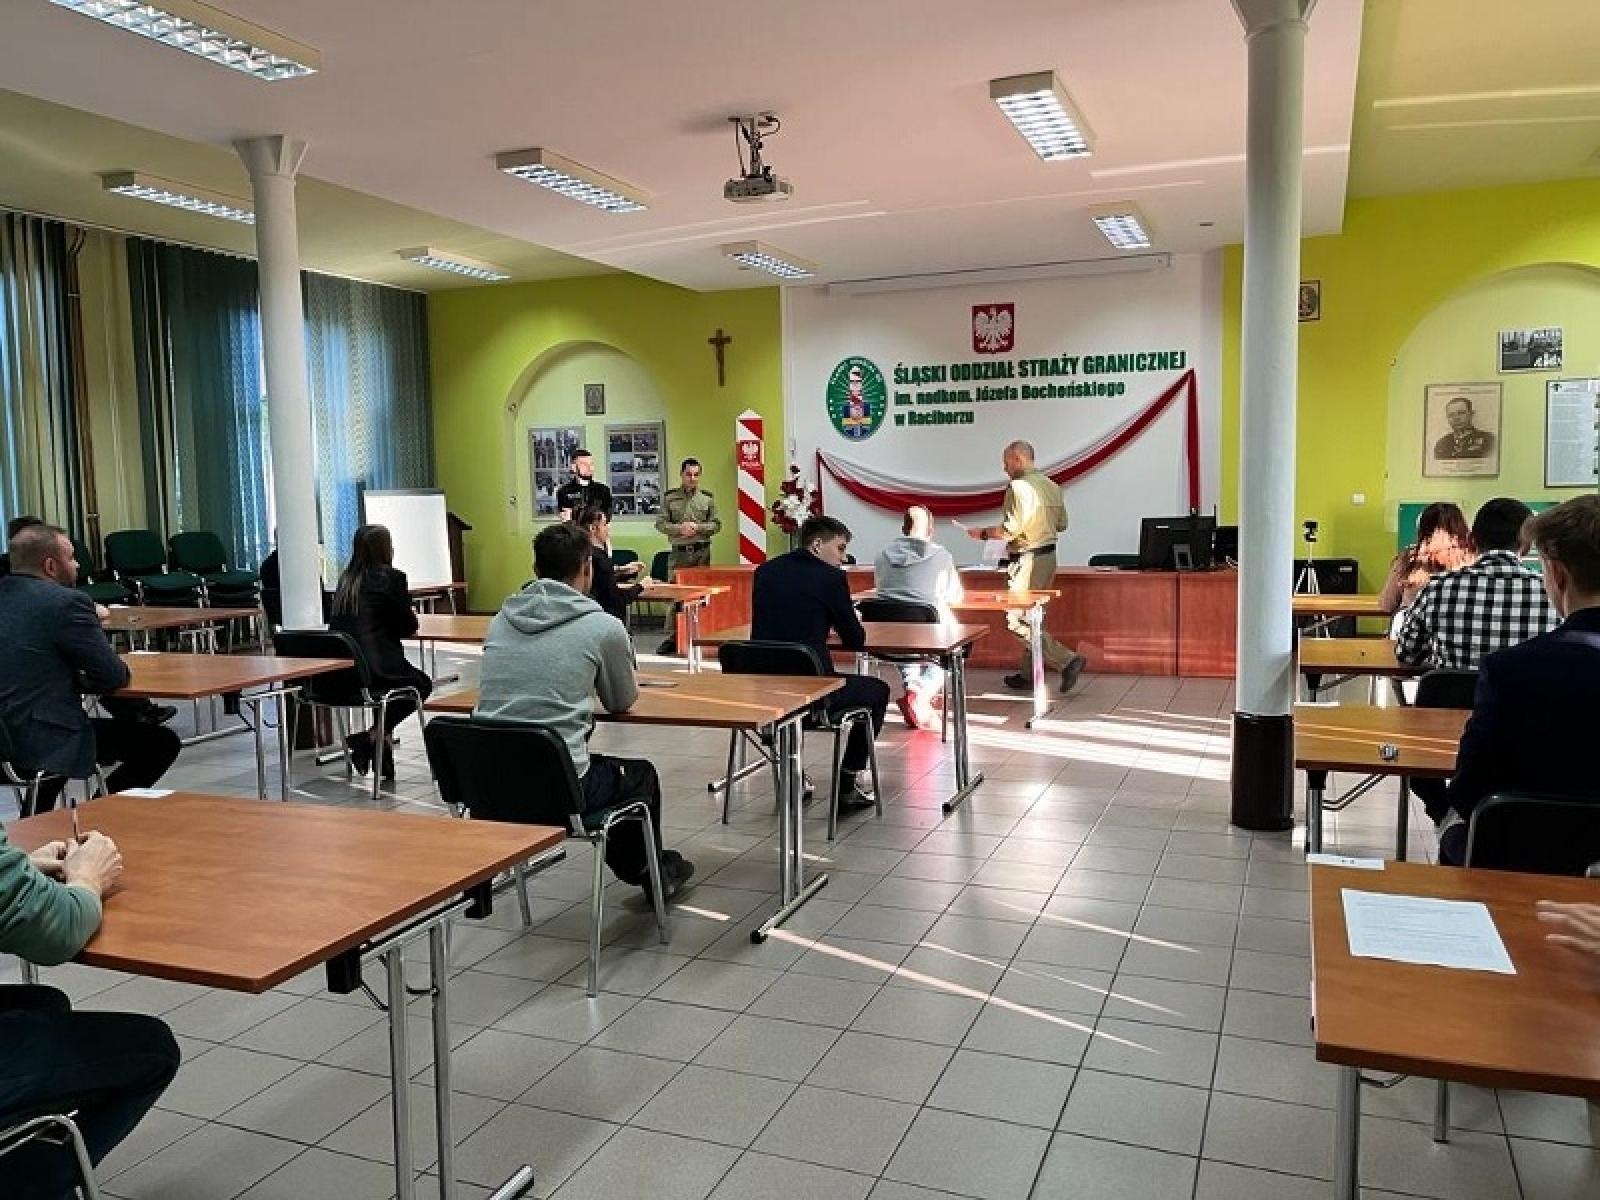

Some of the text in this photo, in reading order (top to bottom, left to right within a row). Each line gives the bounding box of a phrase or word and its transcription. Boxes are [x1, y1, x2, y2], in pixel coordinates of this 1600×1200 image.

[893, 361, 946, 386] ŚLĄSKI
[950, 360, 1015, 382] ODDZIAŁ
[1017, 352, 1080, 378] STRAŻY
[1083, 349, 1187, 375] GRANICZNEJ
[975, 385, 1019, 402] Józefa
[1021, 380, 1126, 400] Bocheńskiego
[907, 409, 975, 427] Raciborzu
